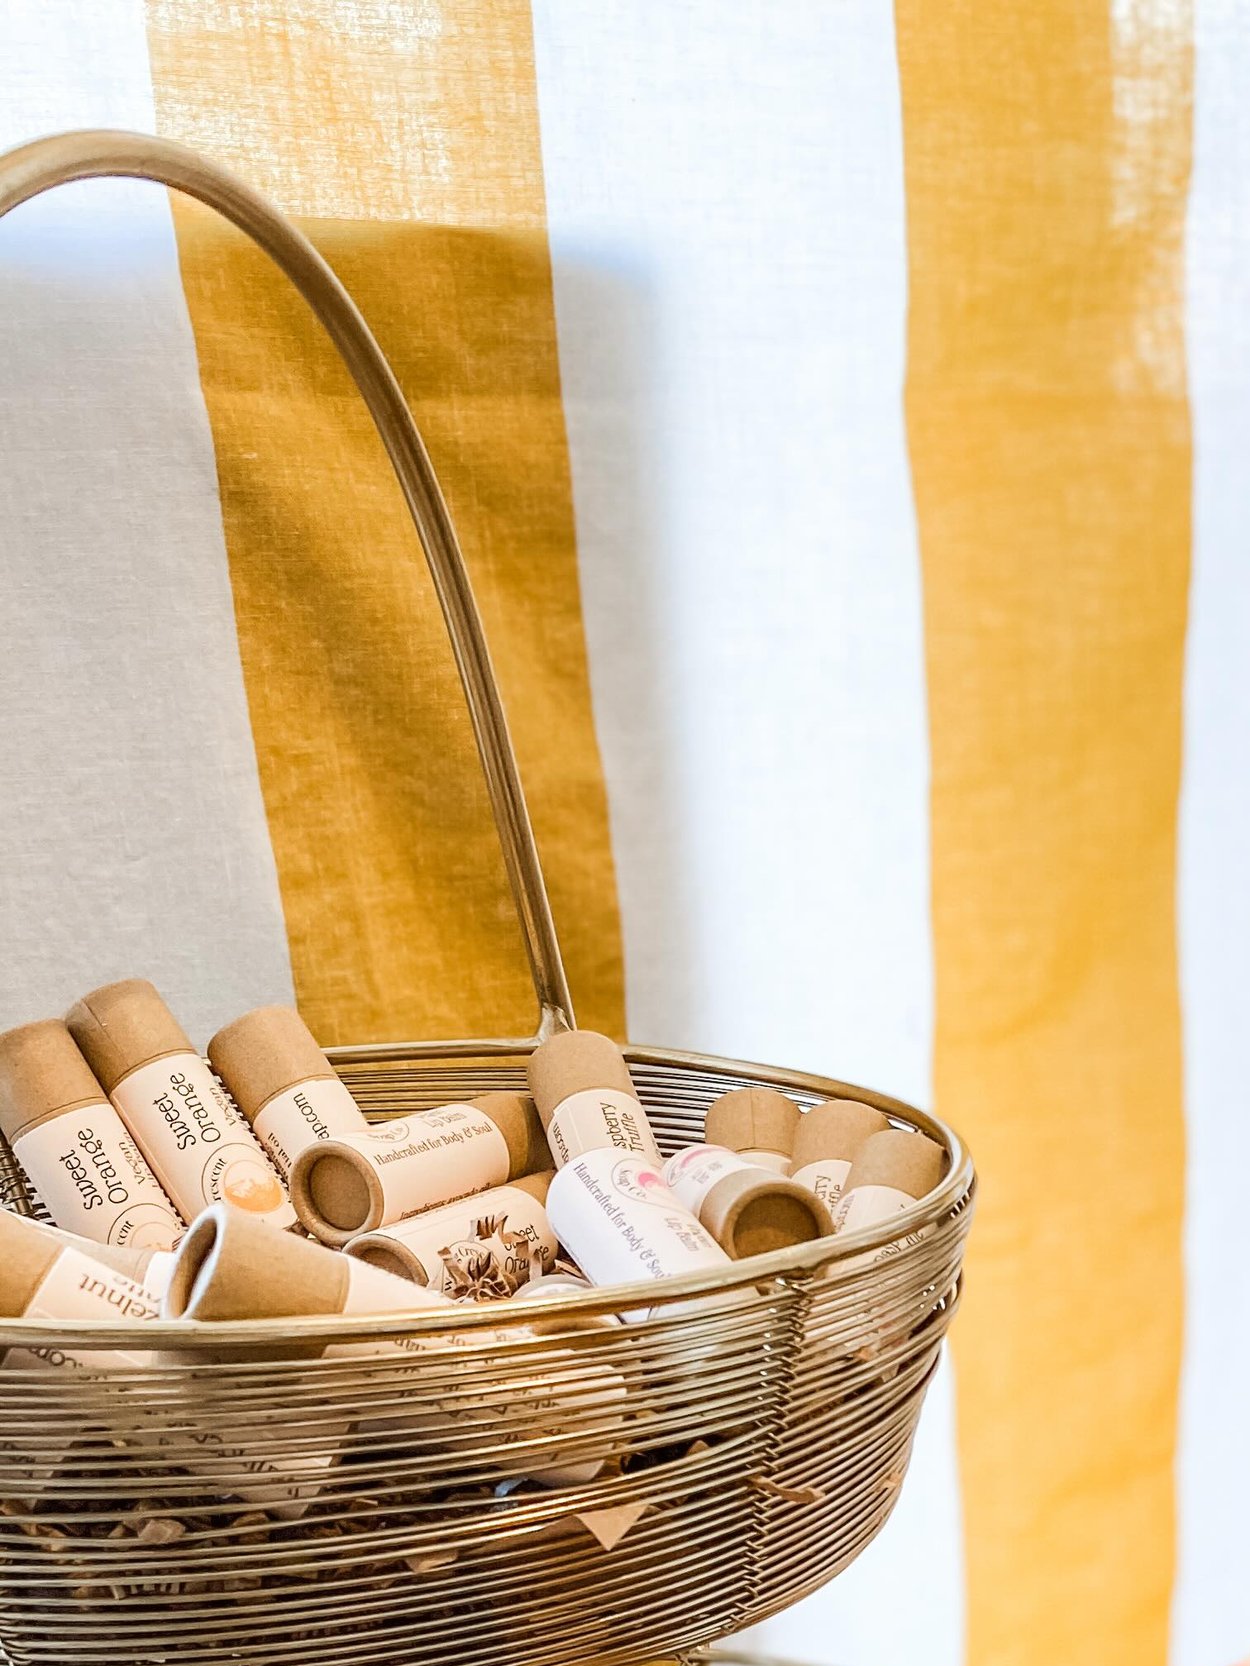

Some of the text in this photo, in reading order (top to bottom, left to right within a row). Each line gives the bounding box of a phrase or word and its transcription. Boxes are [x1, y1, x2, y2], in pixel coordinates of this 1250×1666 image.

[153, 1092, 197, 1151] Sweet
[170, 1072, 221, 1143] Orange
[620, 1112, 645, 1152] Truffle
[77, 1128, 129, 1204] Orange
[373, 1121, 494, 1166] Handcrafted for Body & Soul
[59, 1149, 104, 1210] Sweet
[572, 1162, 672, 1279] Handcrafted for Body & Sou
